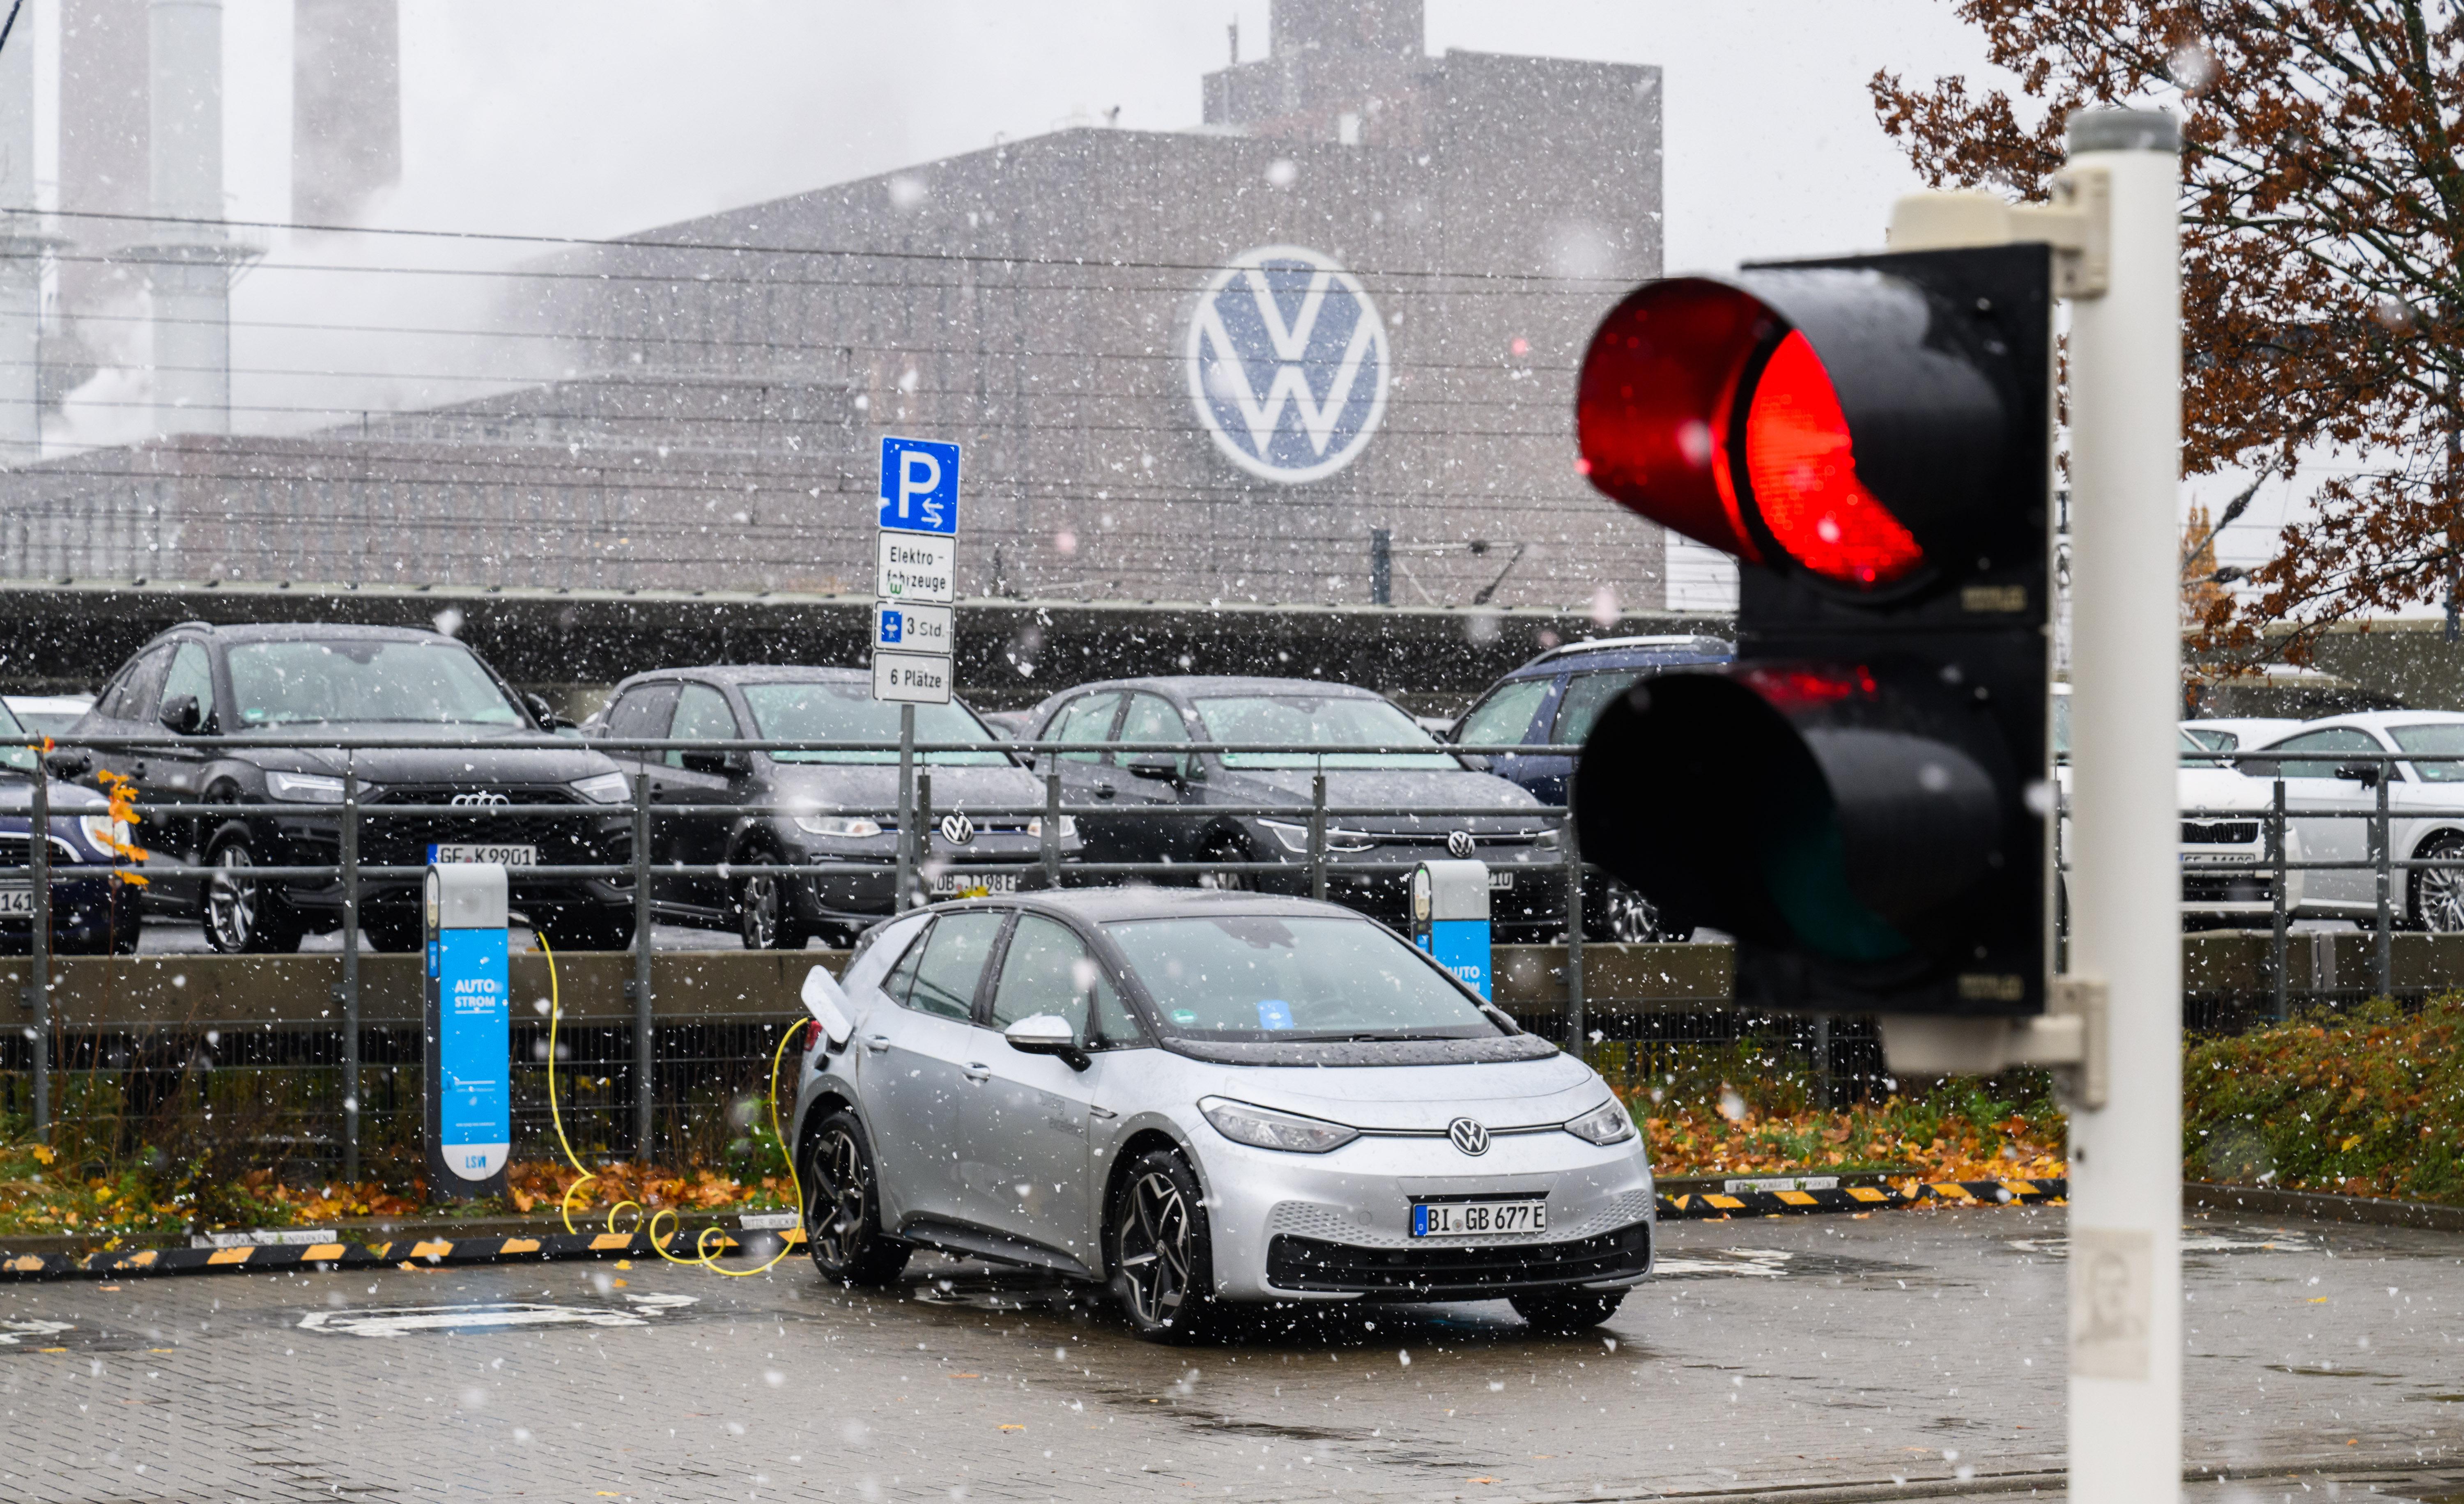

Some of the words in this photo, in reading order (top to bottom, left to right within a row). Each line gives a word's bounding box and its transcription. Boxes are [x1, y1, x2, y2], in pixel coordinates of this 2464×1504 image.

[898, 450, 941, 518] P
[907, 617, 915, 634] 3
[890, 668, 898, 685] 6
[905, 669, 941, 688] Plätze
[930, 874, 954, 891] OB
[454, 978, 495, 994] AUTO
[454, 995, 496, 1008] STROM
[465, 1155, 486, 1169] LSW
[1428, 1208, 1450, 1232] BI
[1466, 1207, 1489, 1231] GB
